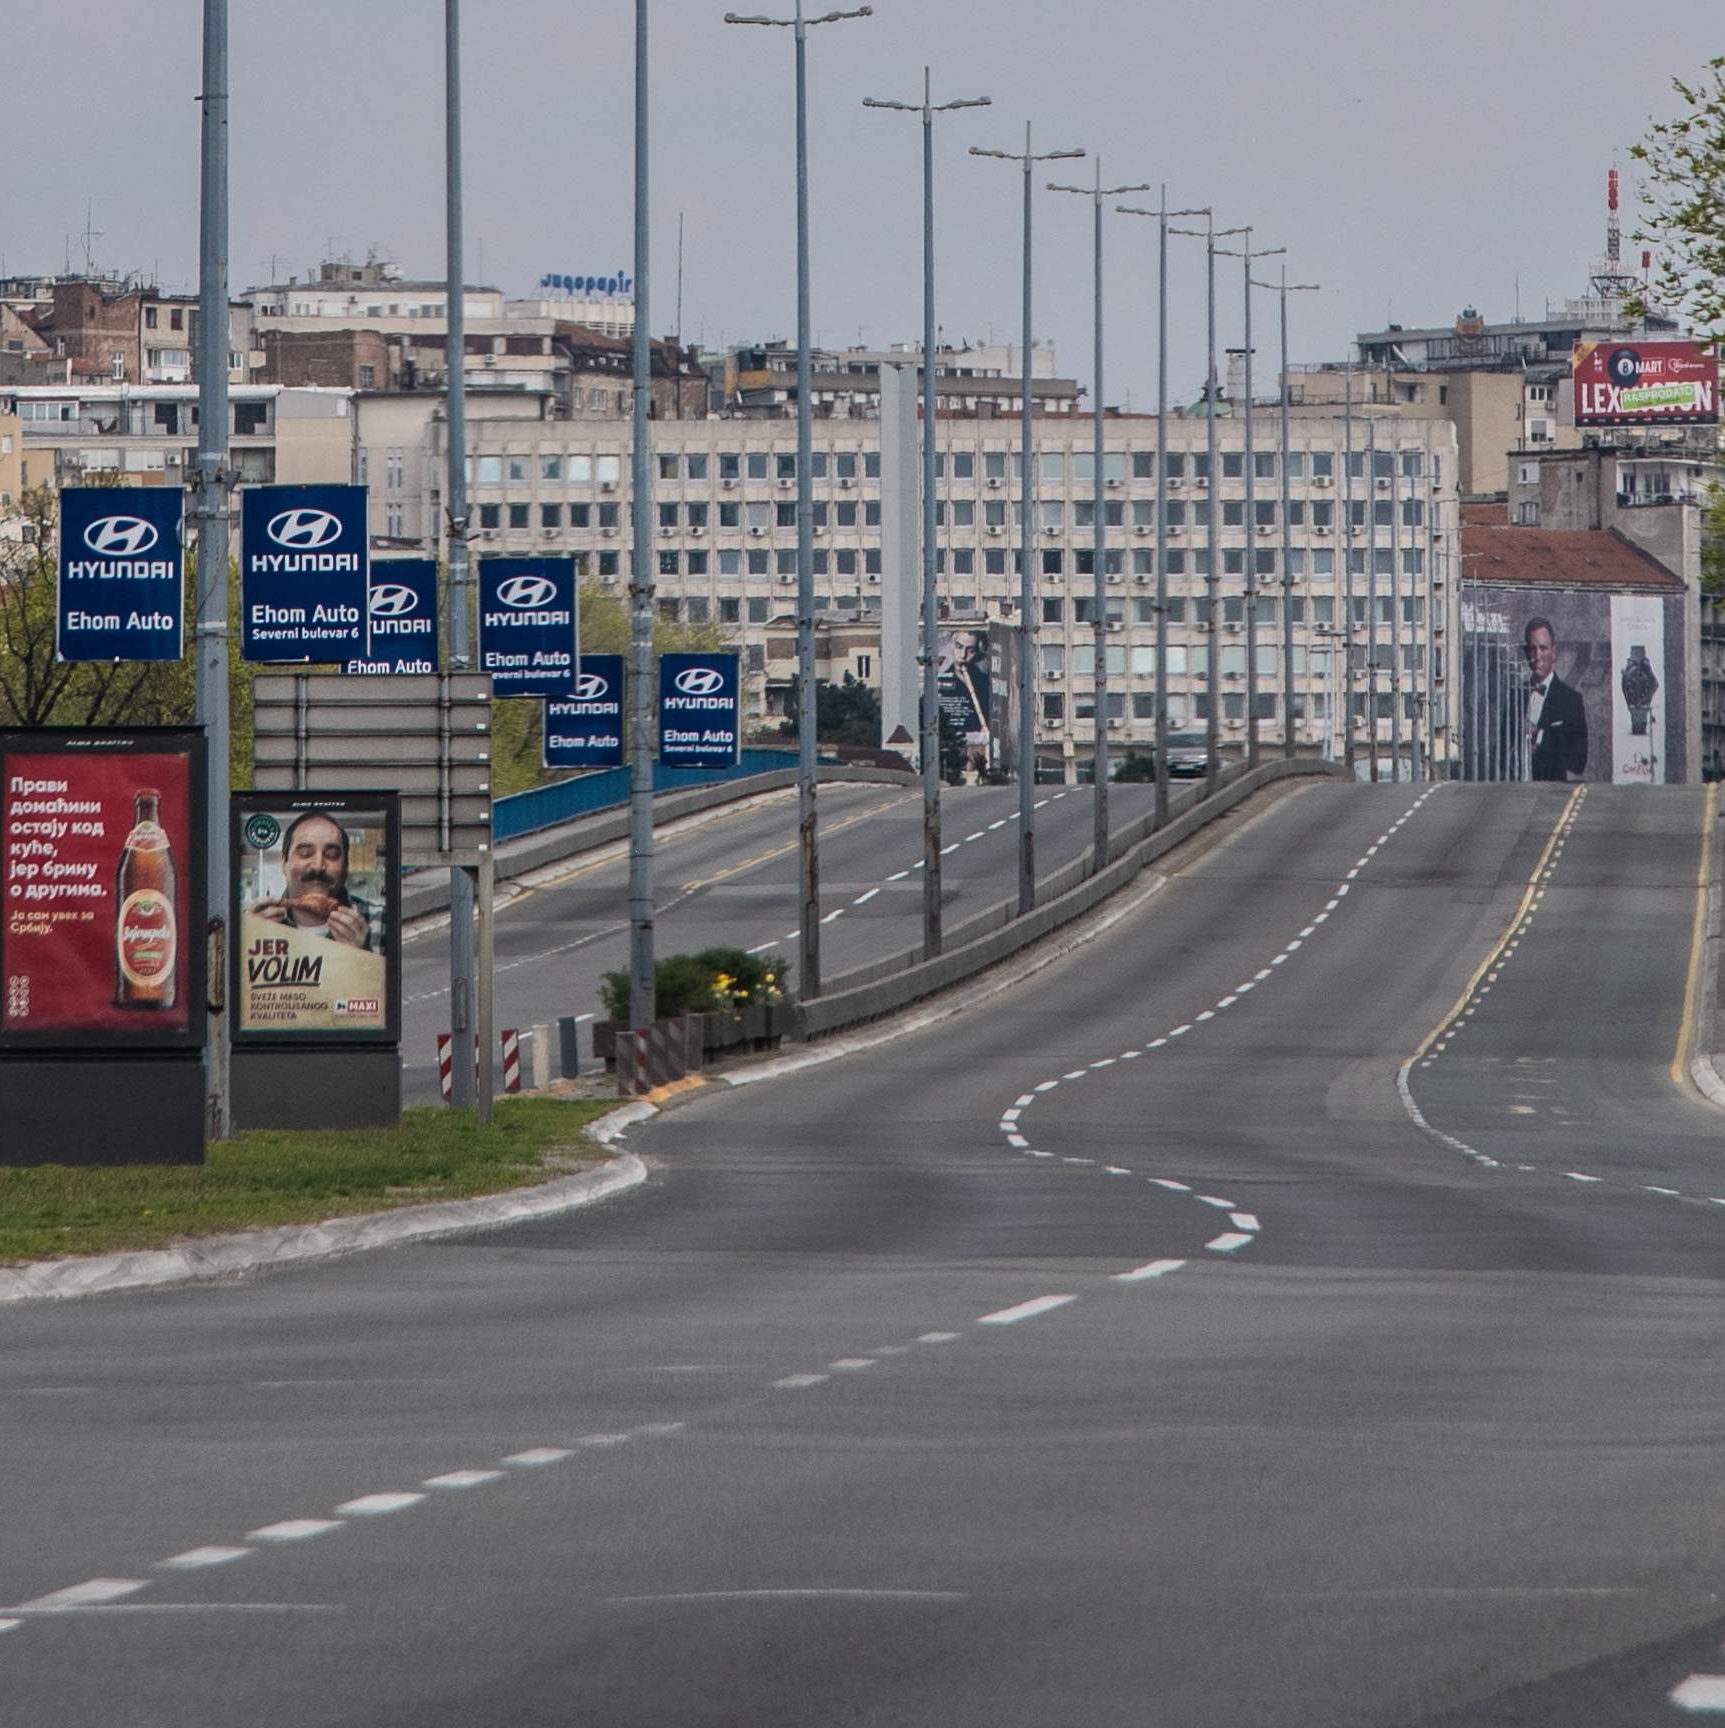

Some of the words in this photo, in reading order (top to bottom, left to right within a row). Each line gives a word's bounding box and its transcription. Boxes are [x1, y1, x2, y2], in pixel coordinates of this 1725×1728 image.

[1635, 360, 1663, 374] MART
[1624, 385, 1694, 403] RASPRODATO
[68, 561, 173, 579] HYUNDAI
[252, 553, 358, 572] HYUNDAI
[67, 611, 120, 630] Ehom
[126, 611, 173, 630] Auto
[252, 605, 306, 623] Ehom
[312, 604, 359, 623] Auto
[485, 611, 569, 626] HYUNDAI
[252, 627, 298, 639] Severni
[302, 626, 348, 639] bulevar
[351, 627, 359, 638] 6
[370, 619, 431, 634] UNDAI
[348, 660, 390, 674] Ehom
[394, 659, 432, 673] Auto
[485, 652, 528, 667] Ehom
[533, 651, 571, 666] Auto
[491, 670, 523, 679] everni
[549, 703, 618, 715] HYUNDAI
[665, 698, 733, 710] HYUNDAI
[549, 735, 585, 748] Ehom
[587, 735, 619, 747] Auto
[663, 729, 699, 742] Ehom
[702, 729, 733, 742] Auto
[10, 776, 68, 797] Прави
[10, 797, 102, 816] домаћини
[10, 817, 68, 838] остају
[71, 821, 105, 837] код
[10, 839, 58, 859] куће,
[9, 859, 40, 880] јер
[42, 860, 98, 880] брину
[10, 884, 22, 897] о
[25, 884, 108, 901] другима.
[11, 910, 26, 921] Ја
[27, 912, 50, 921] сам
[52, 912, 79, 922] увек
[80, 912, 95, 921] за
[10, 922, 54, 935] Србију.
[248, 939, 290, 956] JER
[248, 955, 323, 983] VOLIM
[250, 1002, 328, 1011] KONTROLISANOG
[349, 1001, 377, 1011] MAXI
[250, 1011, 297, 1021] KVALITETA
